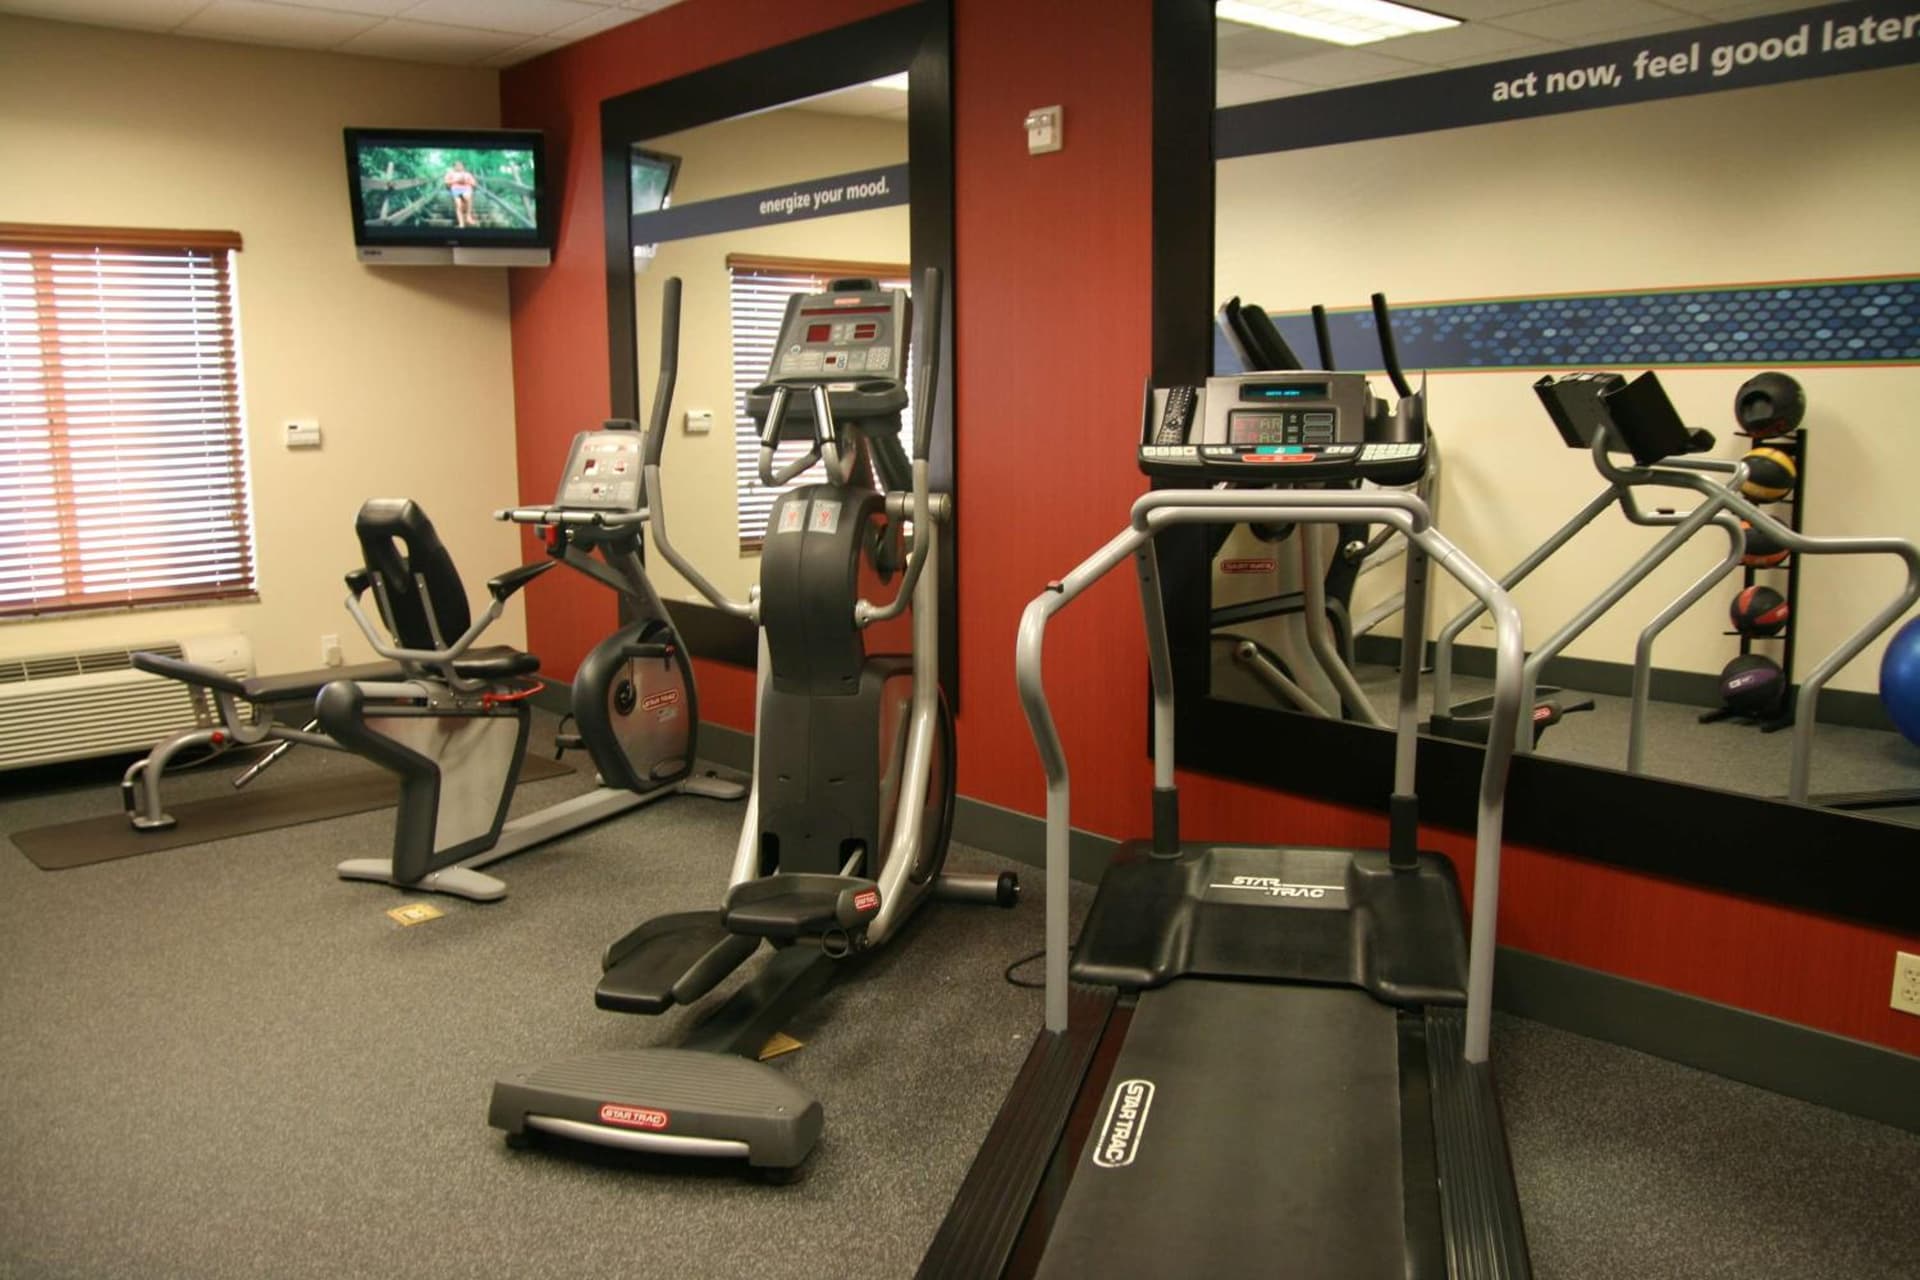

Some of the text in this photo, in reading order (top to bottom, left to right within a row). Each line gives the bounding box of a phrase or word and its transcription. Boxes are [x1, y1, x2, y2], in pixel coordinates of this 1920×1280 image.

[1492, 72, 1539, 102] act
[1546, 64, 1622, 94] now,
[1633, 42, 1700, 81] feel
[1711, 24, 1810, 77] good
[759, 176, 890, 215] energize your mood.
[1232, 876, 1280, 887] STAR
[1271, 887, 1325, 898] TRAC
[605, 1109, 662, 1124] STAR TRAC
[1105, 1082, 1144, 1161] STAR TRAC
